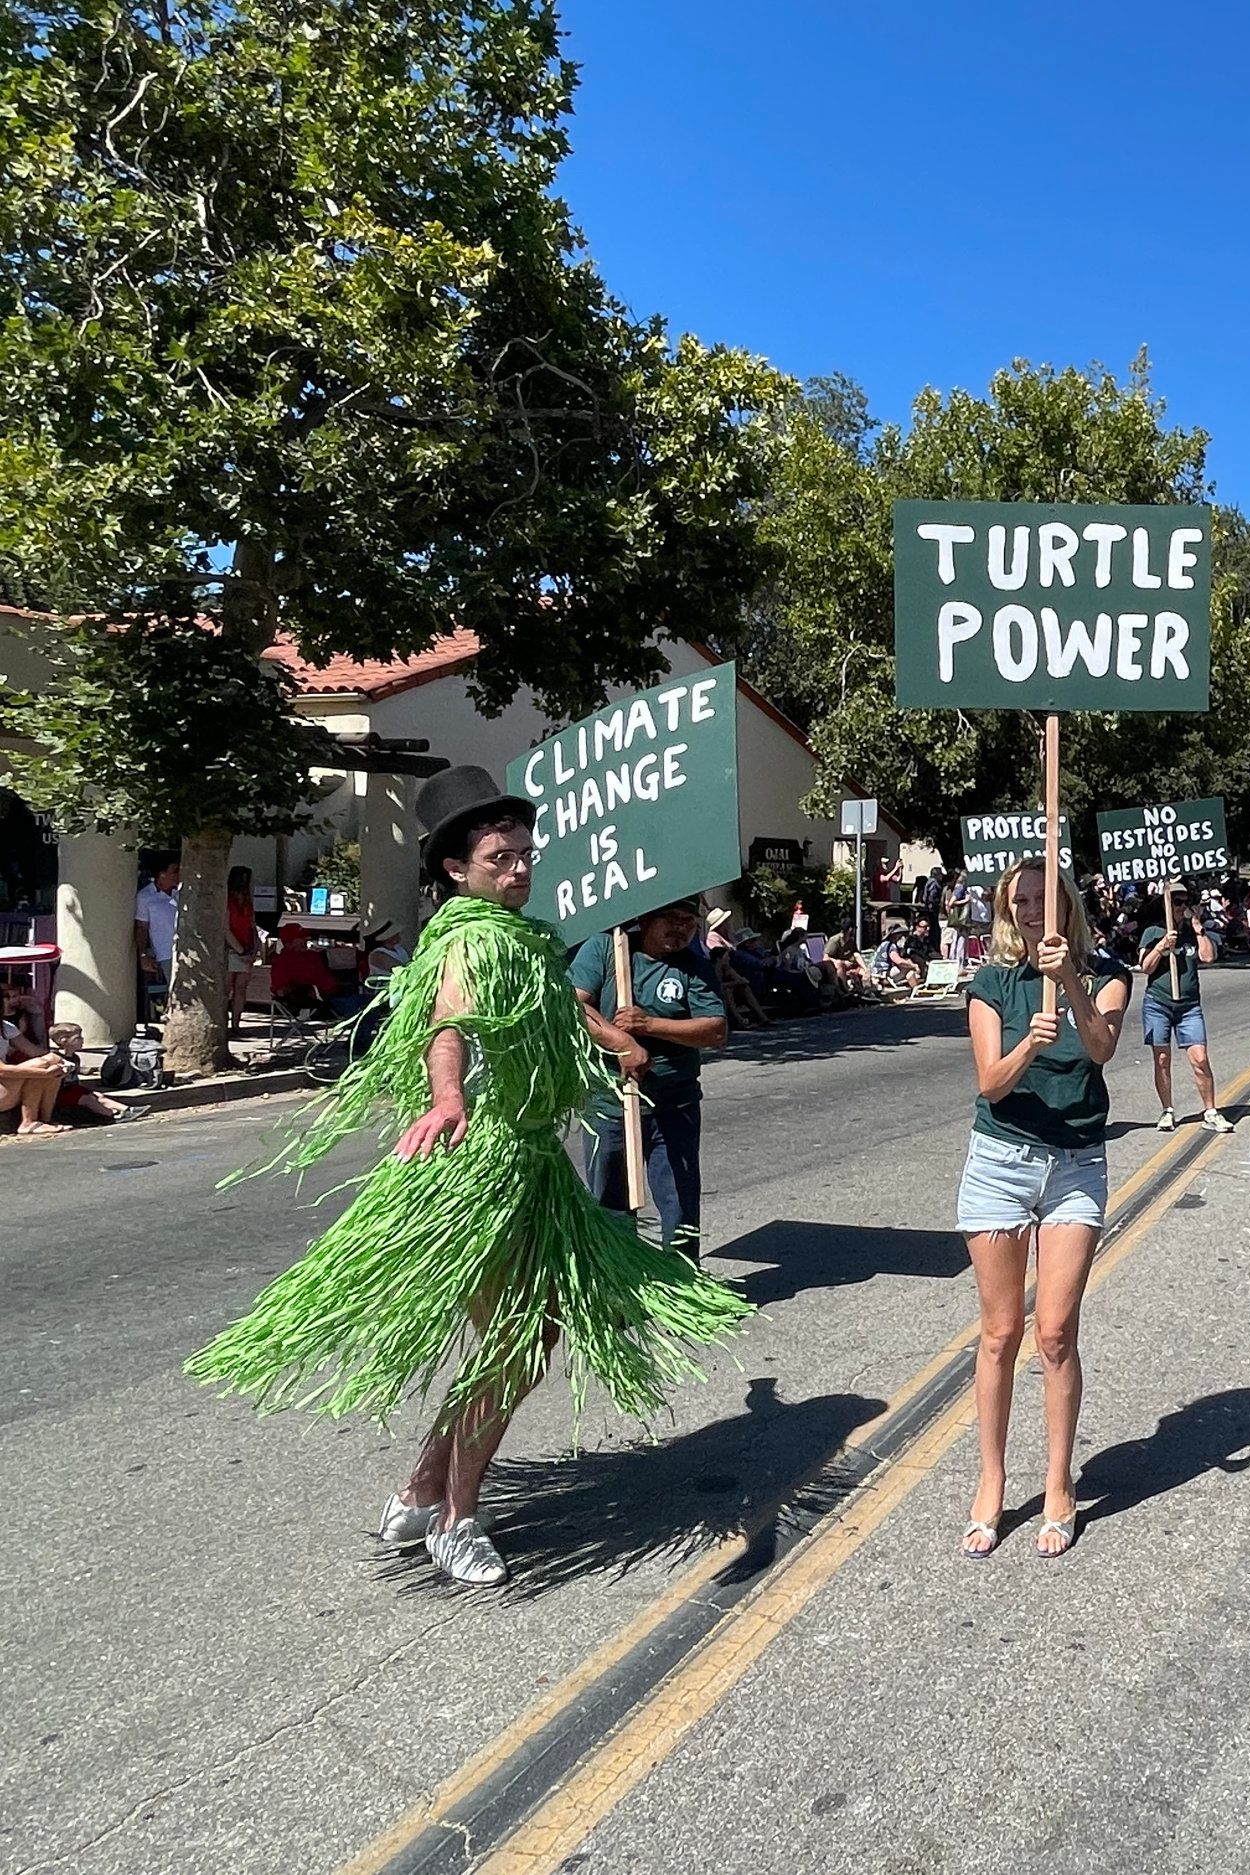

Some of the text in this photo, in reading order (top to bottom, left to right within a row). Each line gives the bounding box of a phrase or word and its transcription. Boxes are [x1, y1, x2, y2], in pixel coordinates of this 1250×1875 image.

[917, 522, 1203, 591] TURTLE
[938, 601, 1190, 683] POWER
[525, 678, 717, 797] CLIMATE
[532, 743, 688, 849] CHANGE
[1143, 806, 1177, 826] NO
[590, 825, 619, 865] IS
[1102, 821, 1214, 851] PESTICIDES
[1151, 843, 1176, 859] NO
[557, 848, 657, 920] REAL
[1107, 848, 1228, 883] HERBICIDES
